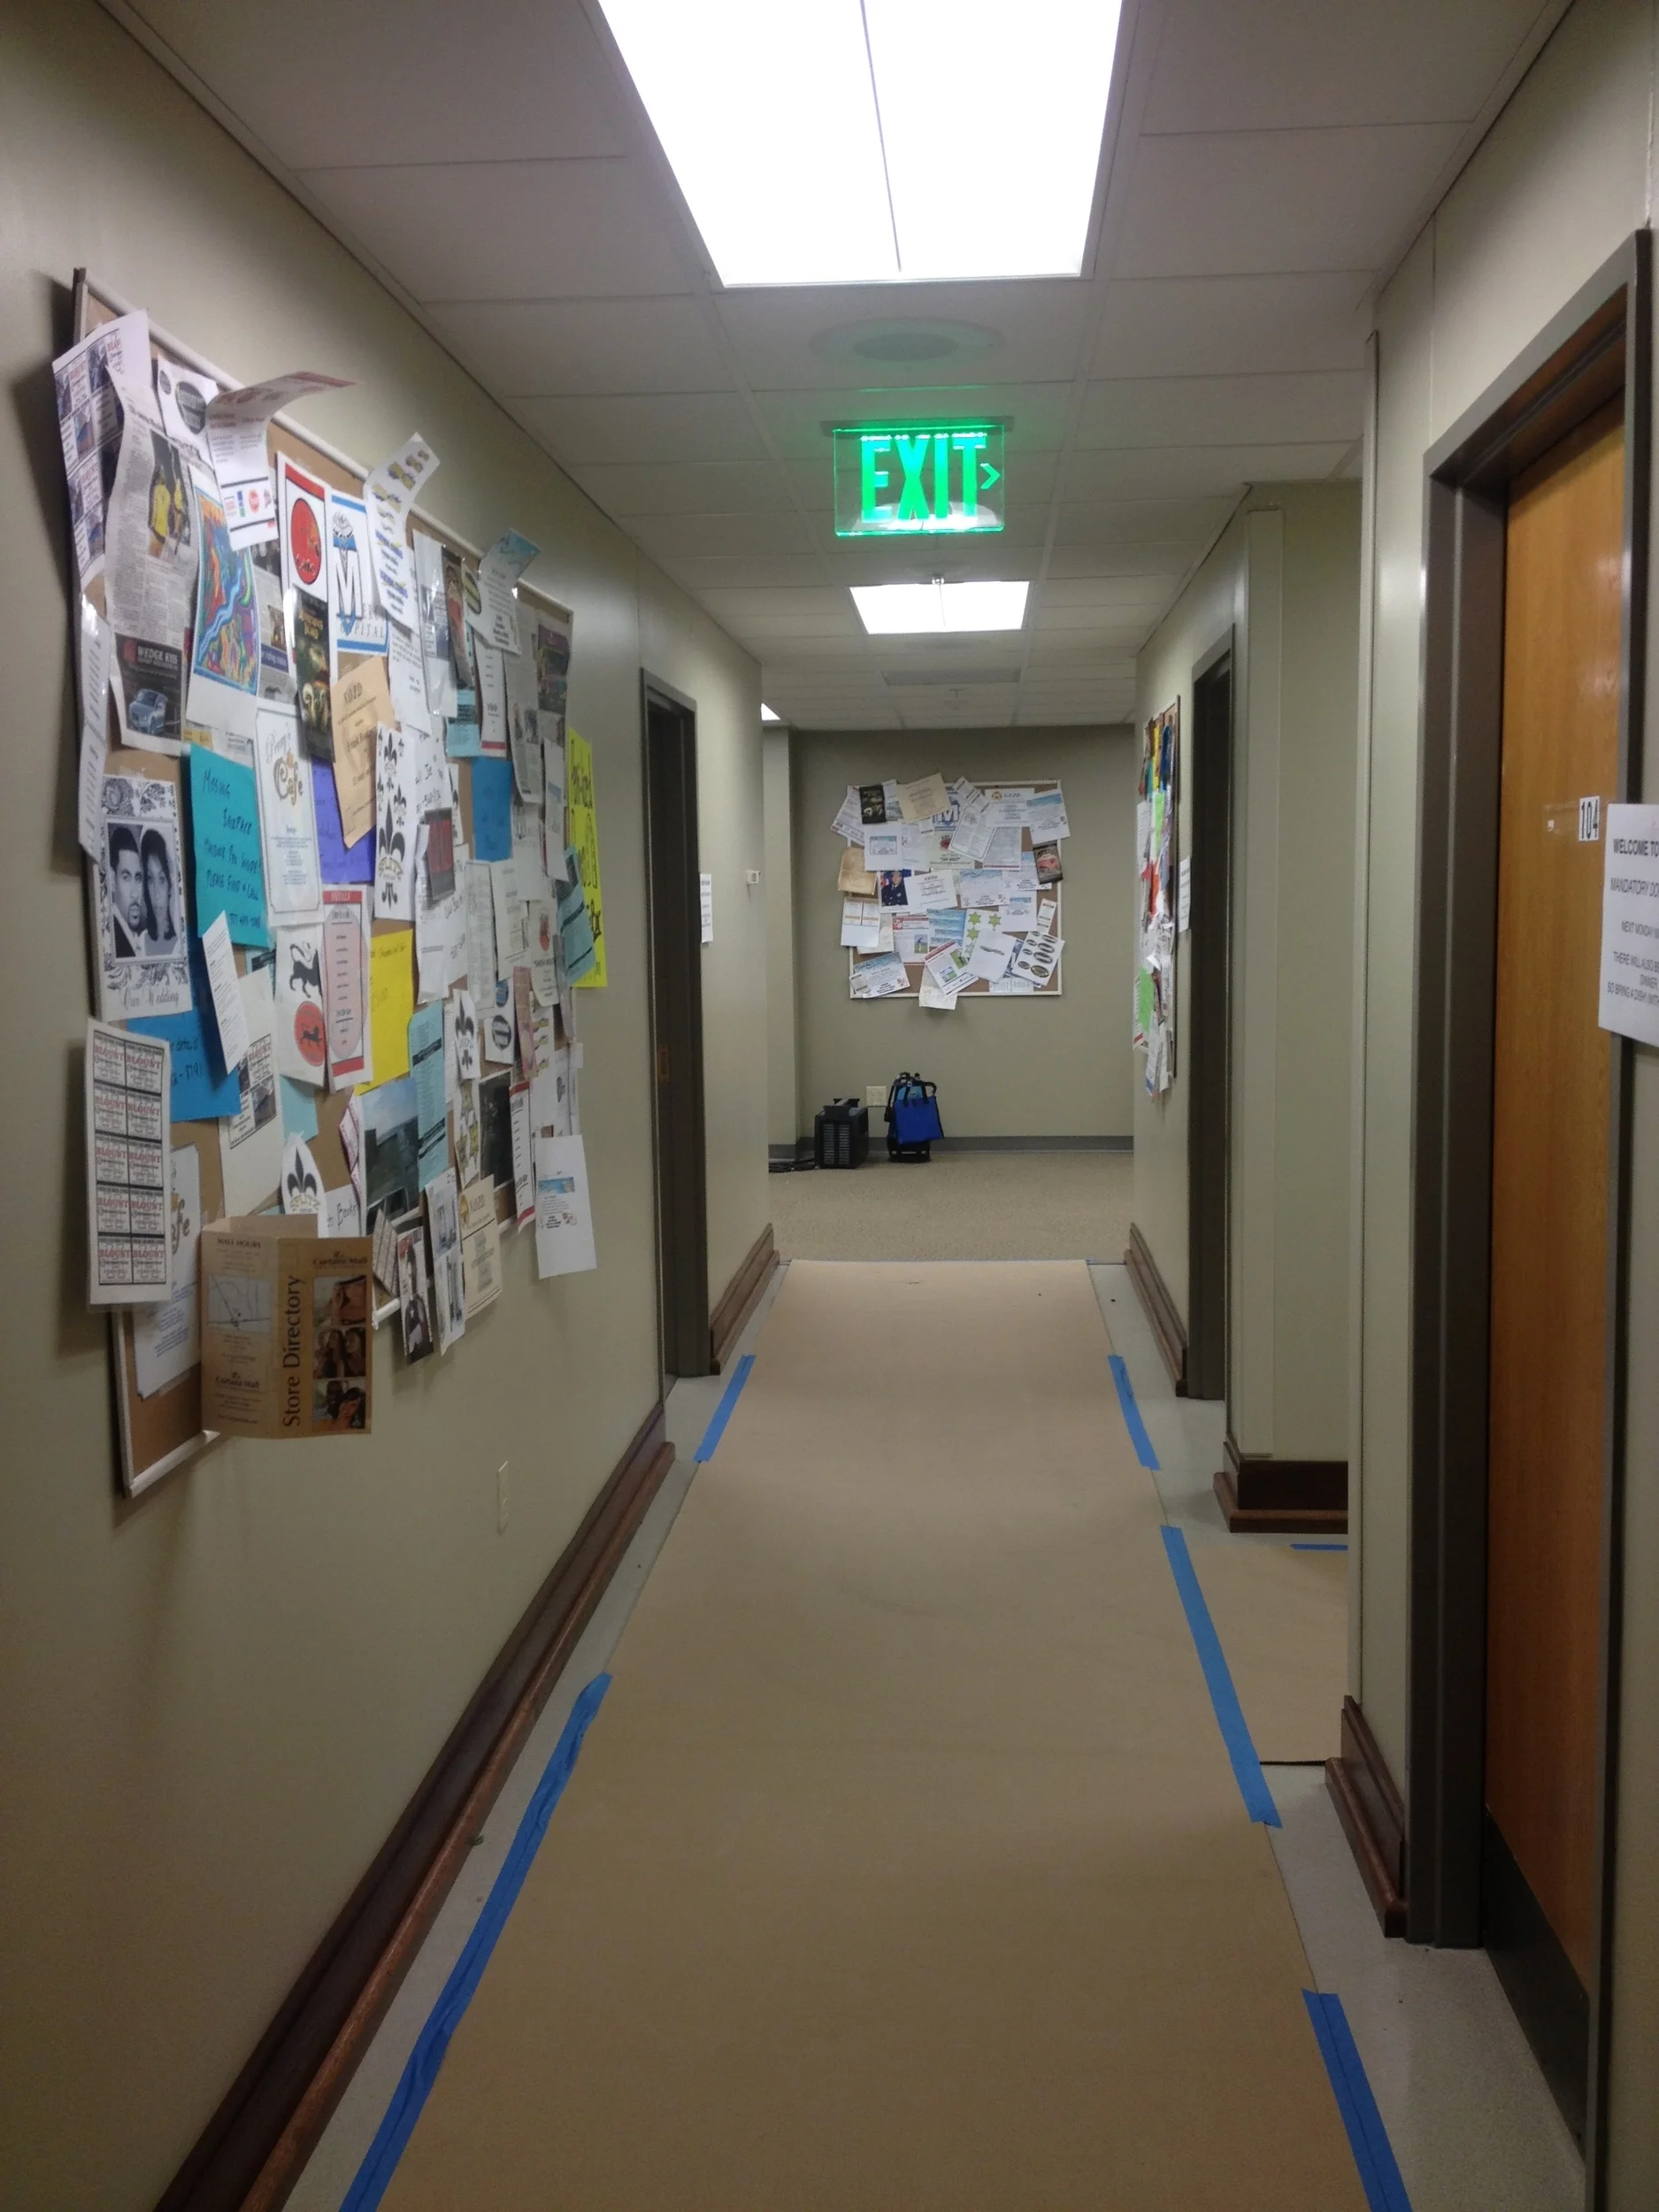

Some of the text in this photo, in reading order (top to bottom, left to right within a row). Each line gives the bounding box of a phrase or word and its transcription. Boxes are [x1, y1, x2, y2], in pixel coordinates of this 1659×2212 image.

[860, 432, 988, 524] EXIT
[1581, 800, 1598, 839] 104
[1613, 838, 1659, 858] WELCOME TO
[1610, 878, 1649, 895] MANDATORY
[1622, 921, 1634, 933] NEXT
[1614, 951, 1629, 965] THERE
[282, 1276, 305, 1427] Store Directory
